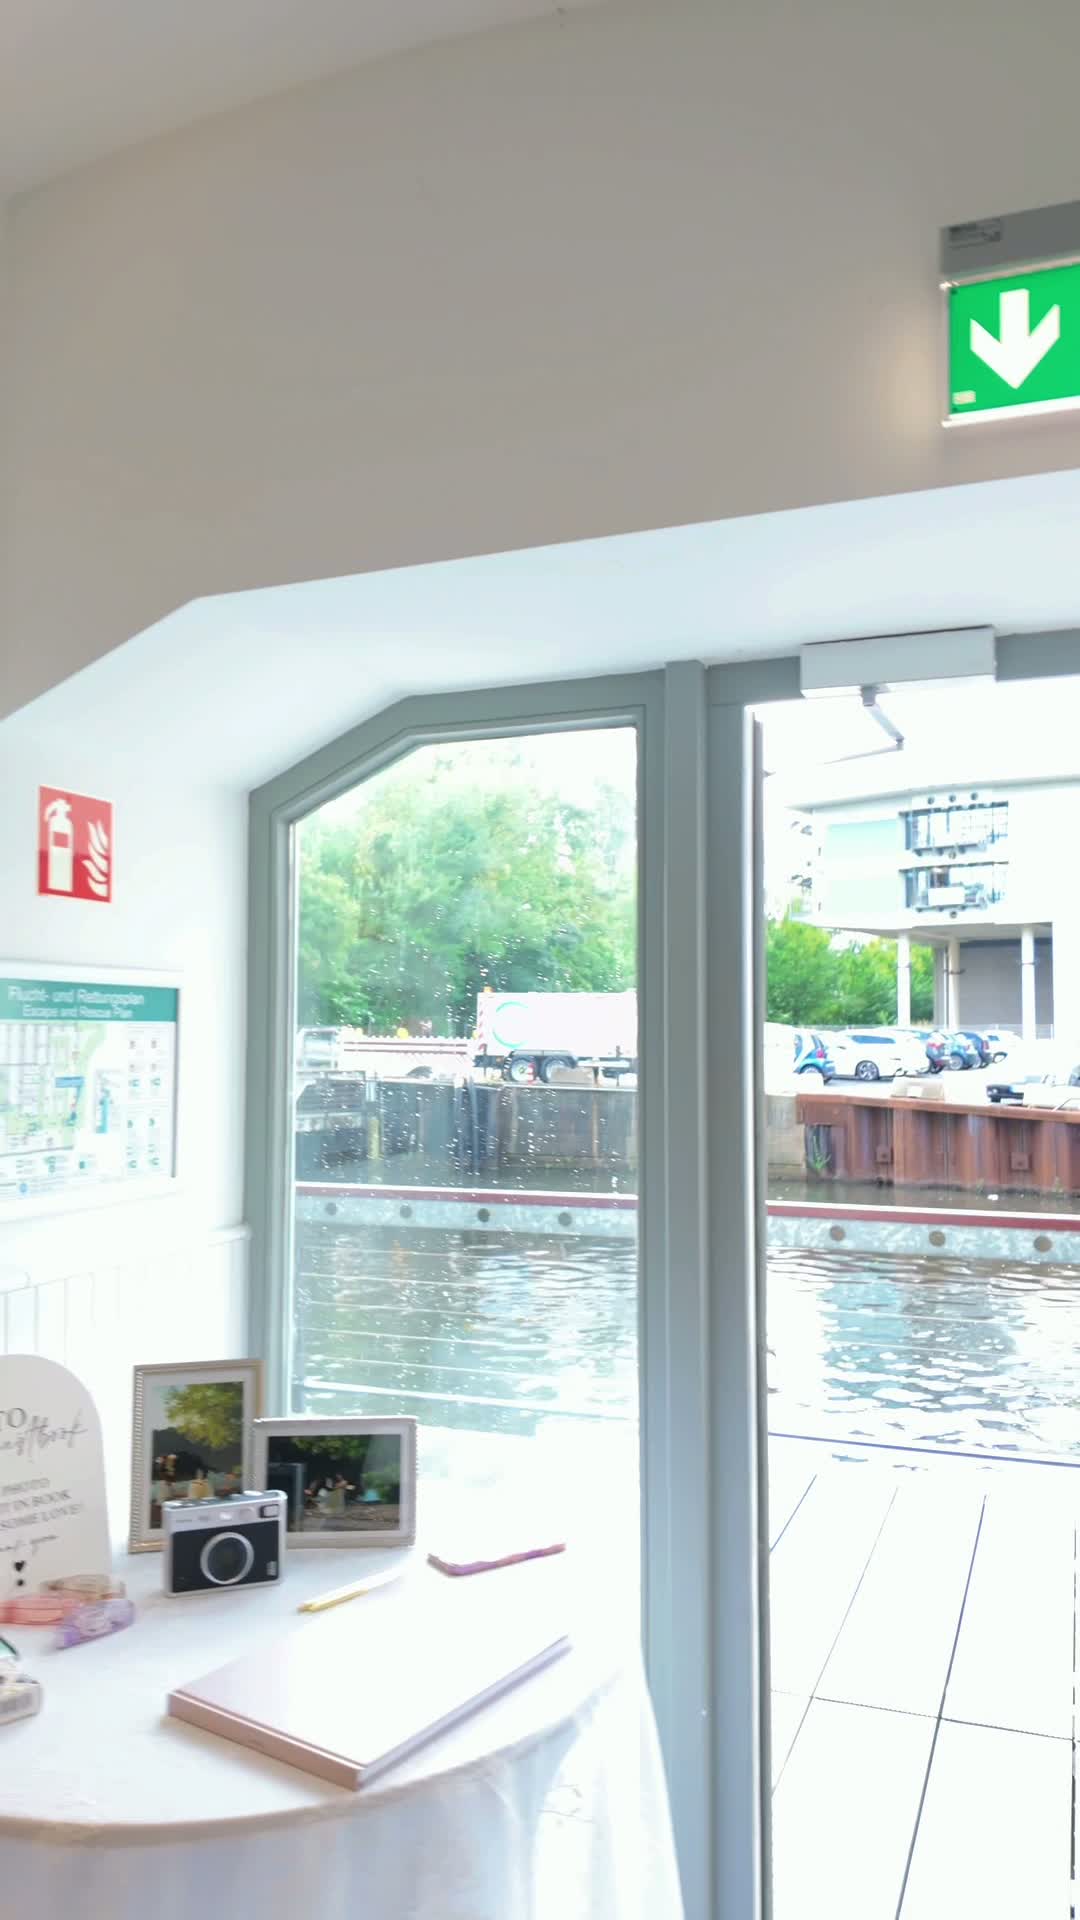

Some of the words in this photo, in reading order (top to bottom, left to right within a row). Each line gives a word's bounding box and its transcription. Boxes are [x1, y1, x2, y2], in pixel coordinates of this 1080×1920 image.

[52, 989, 75, 1003] und
[22, 1003, 59, 1019] Escape
[60, 1006, 78, 1018] and
[79, 1005, 112, 1019] Rescue
[112, 1005, 134, 1020] Plan
[32, 1488, 73, 1506] BOOK
